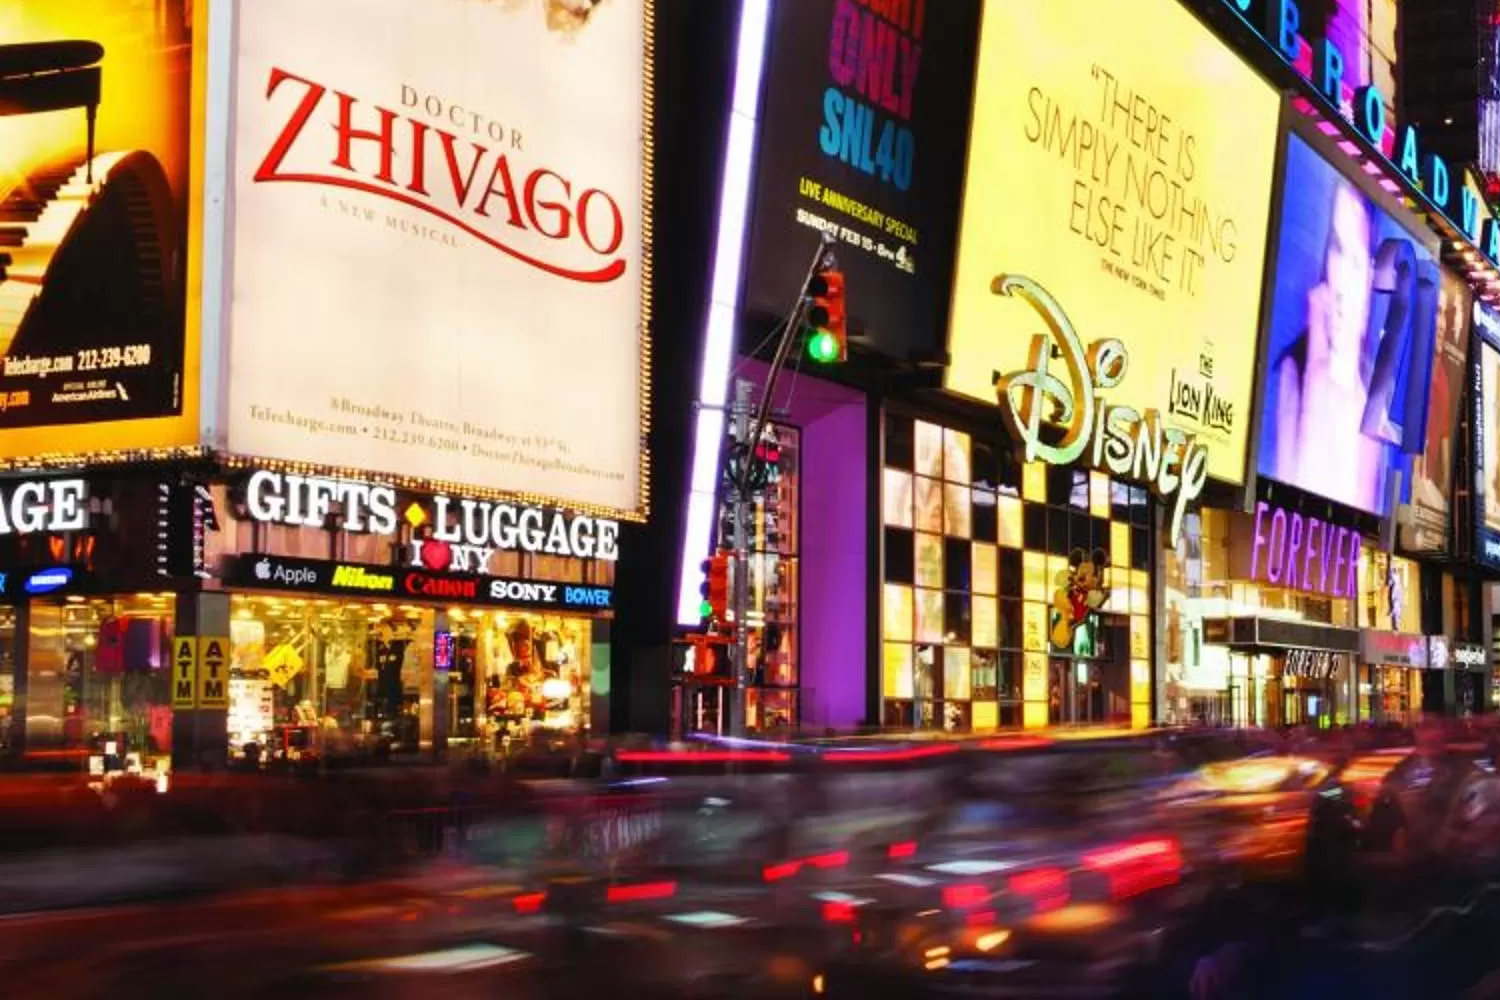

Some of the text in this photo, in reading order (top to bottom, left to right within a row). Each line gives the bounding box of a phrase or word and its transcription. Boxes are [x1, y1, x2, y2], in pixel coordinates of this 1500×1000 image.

[401, 83, 524, 152] DOCTOR
[819, 86, 915, 193] SNL40
[253, 67, 625, 258] ZHIVAGO
[1024, 86, 1239, 264] SIMPLY NOTHING
[1176, 129, 1197, 183] IS
[338, 199, 376, 222] NEW
[385, 214, 461, 248] MUSICAL
[796, 207, 839, 237] SUNDAY
[840, 227, 861, 246] FEB
[799, 176, 918, 245] LIVE ANNIVERSARY SPECIAL
[1068, 179, 1127, 257] ELSE
[1131, 215, 1176, 284] LIKE
[249, 404, 358, 436] Telecharge.com
[1168, 367, 1233, 427] LION KING
[246, 470, 620, 561] GIFTS LUGGAGE
[274, 564, 317, 584] Apple
[332, 565, 394, 592] Nikon
[1251, 501, 1361, 600] FOREVER
[405, 573, 480, 599] Canon
[490, 579, 557, 602] SONY
[176, 640, 192, 698] ATM
[205, 640, 223, 699] ATM
